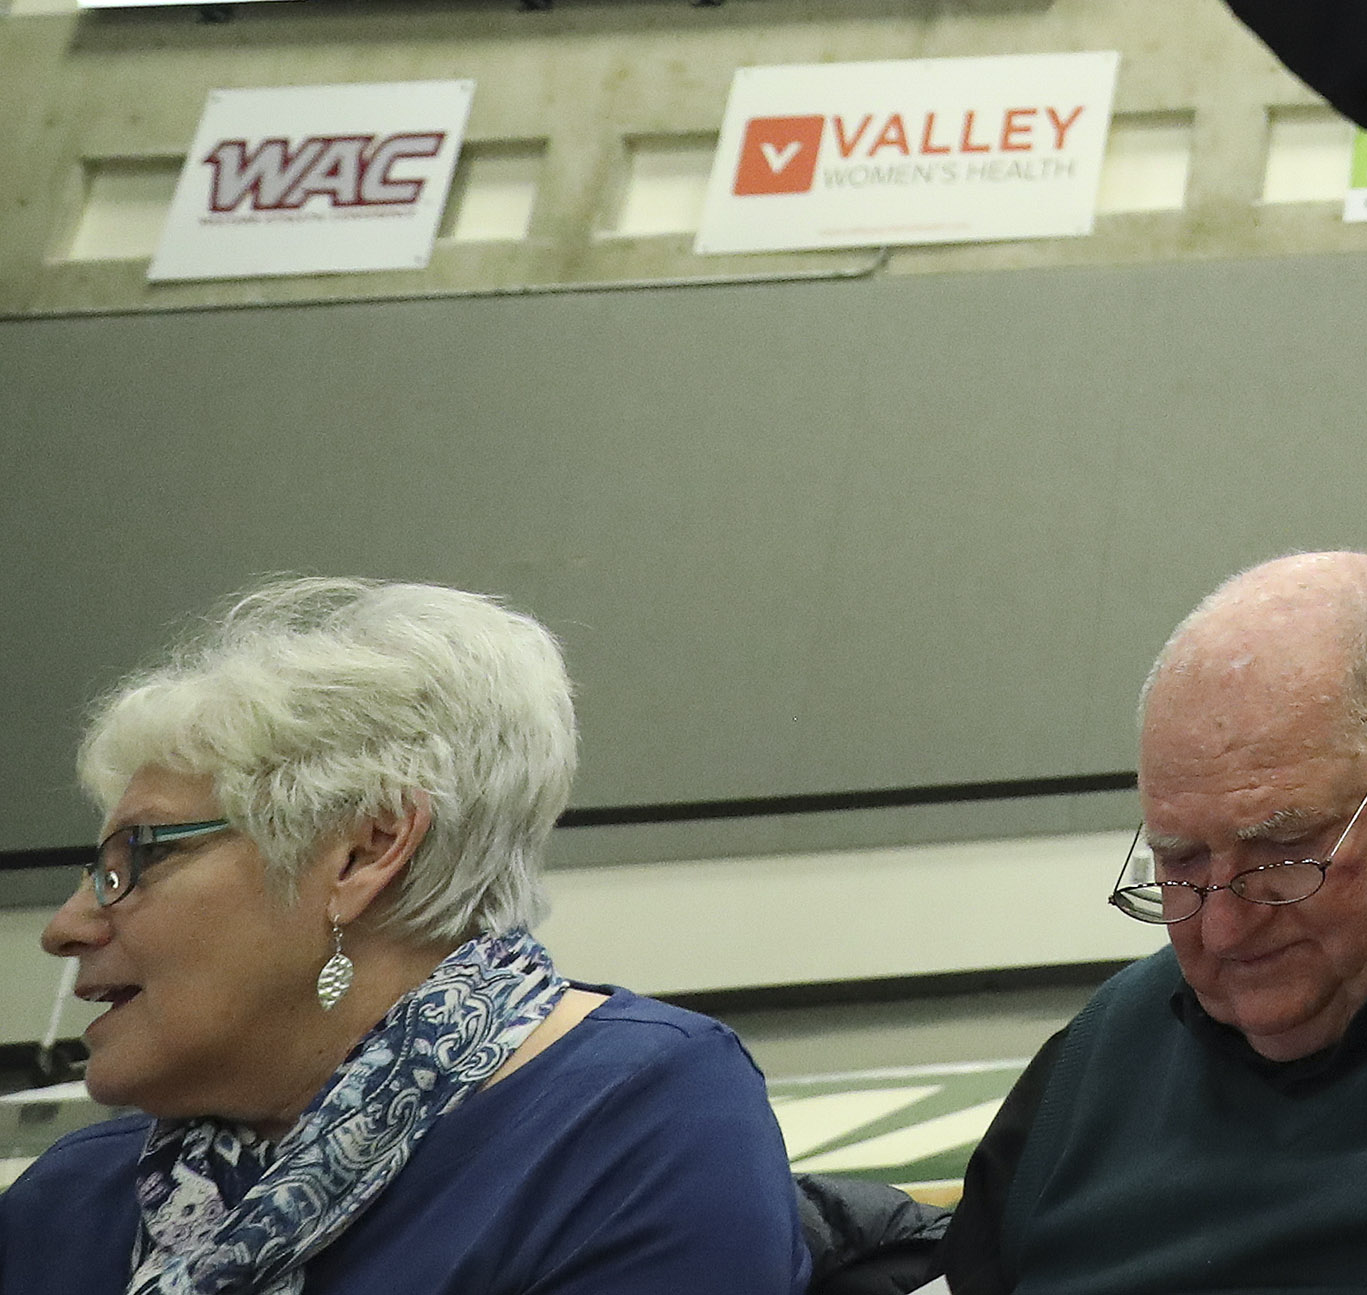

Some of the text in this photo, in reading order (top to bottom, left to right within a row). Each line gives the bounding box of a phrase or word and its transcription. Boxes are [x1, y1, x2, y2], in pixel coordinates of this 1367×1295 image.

[833, 105, 1086, 158] VALLEY
[204, 131, 446, 212] WAC
[824, 157, 1076, 189] WOMEN'S HEALTH
